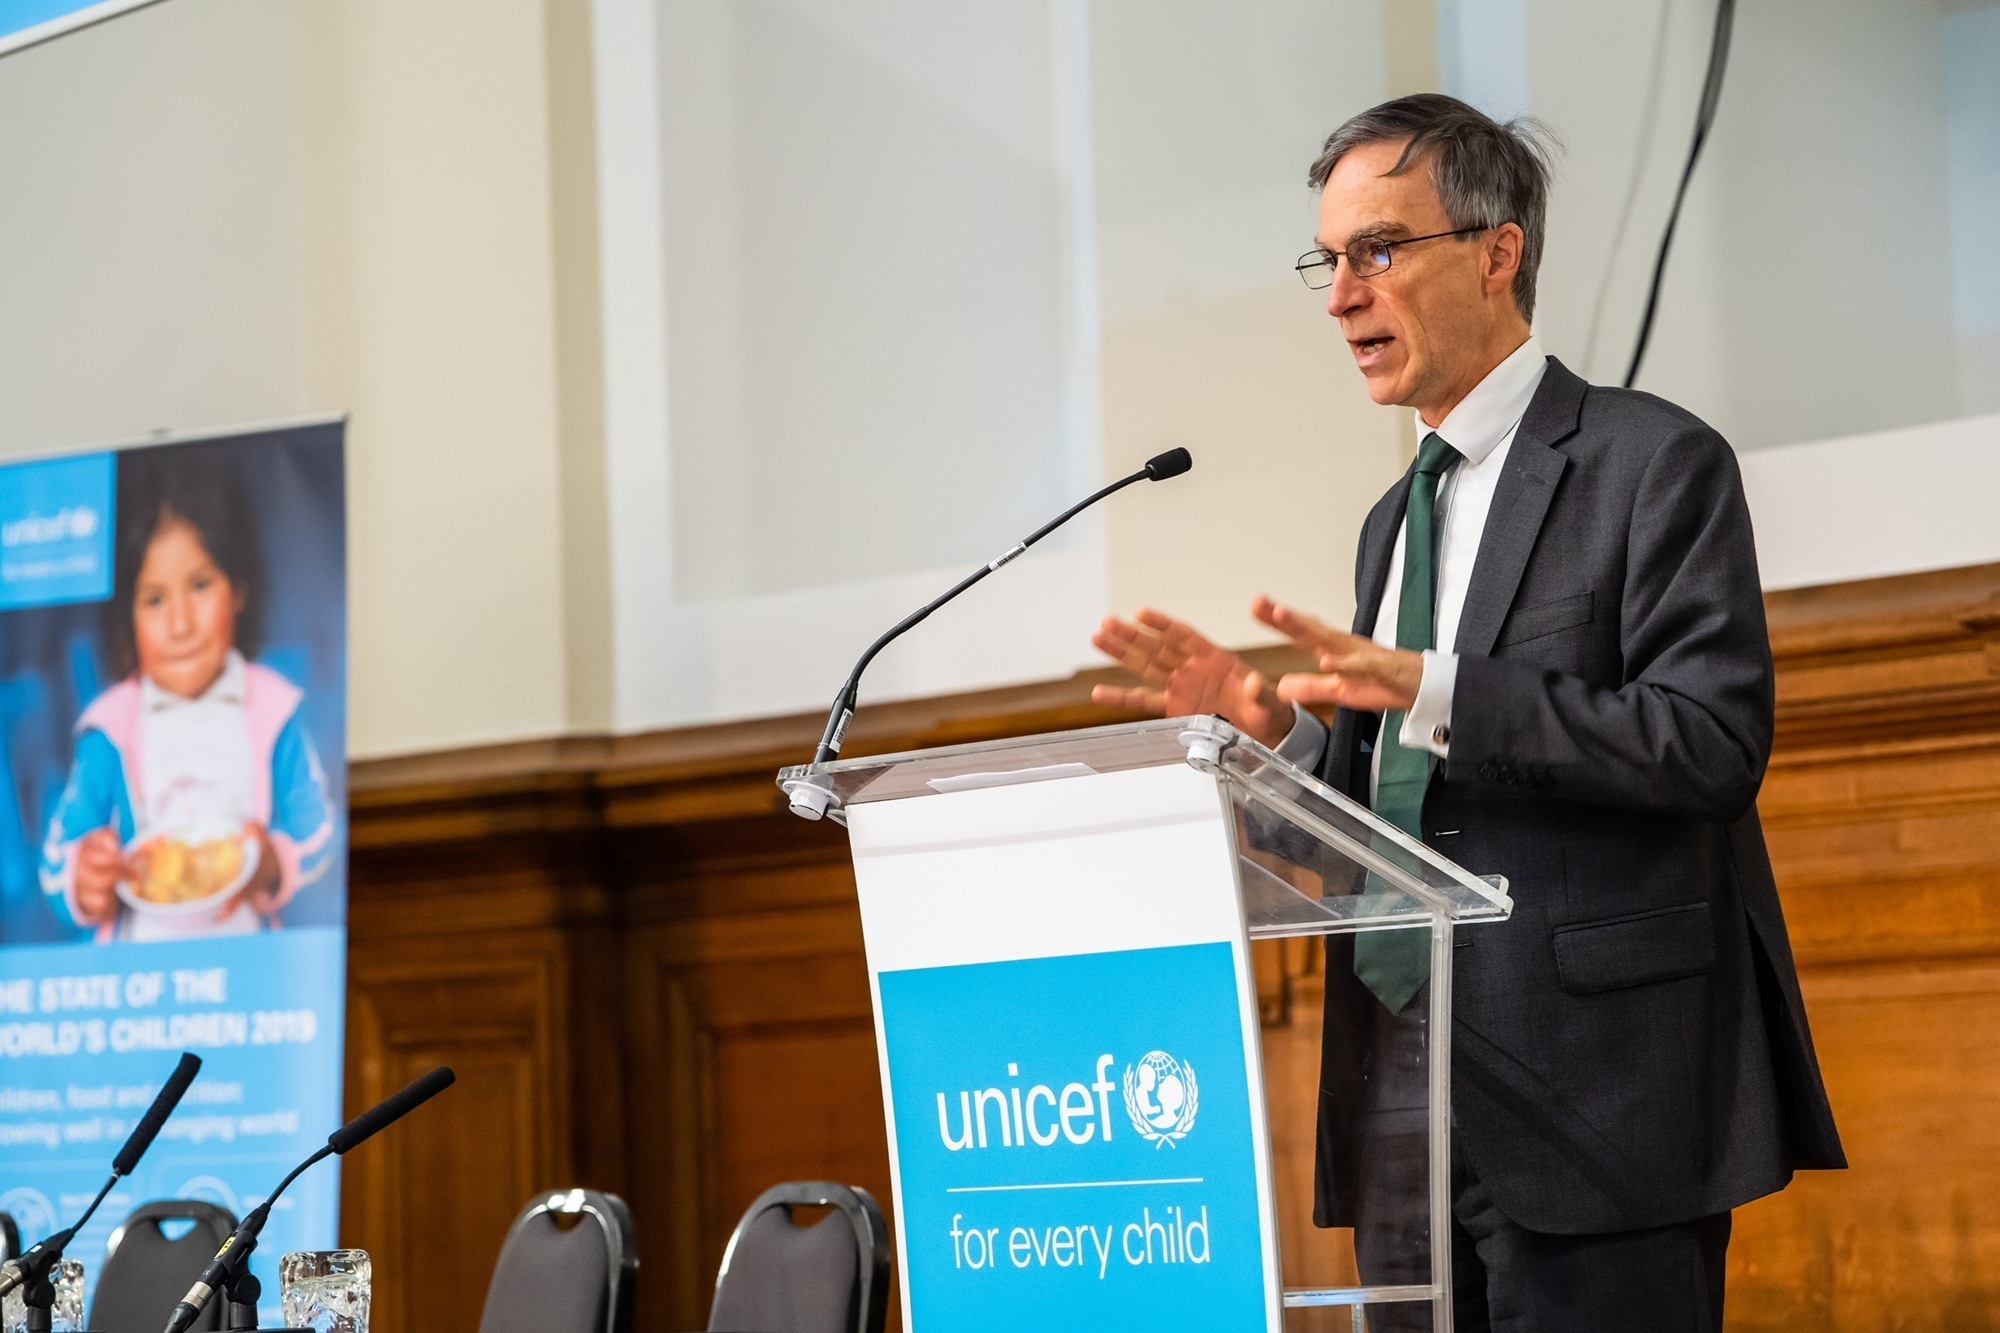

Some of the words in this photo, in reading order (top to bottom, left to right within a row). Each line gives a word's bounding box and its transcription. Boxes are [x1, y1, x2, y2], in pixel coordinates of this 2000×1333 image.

[38, 974, 121, 1013] STATE
[125, 971, 164, 1008] OF
[172, 967, 228, 1004] THE
[110, 1011, 247, 1054] CHILDREN
[936, 1054, 1116, 1152] unicef
[949, 1213, 999, 1269] for
[1008, 1224, 1113, 1279] every
[1122, 1205, 1211, 1266] child
